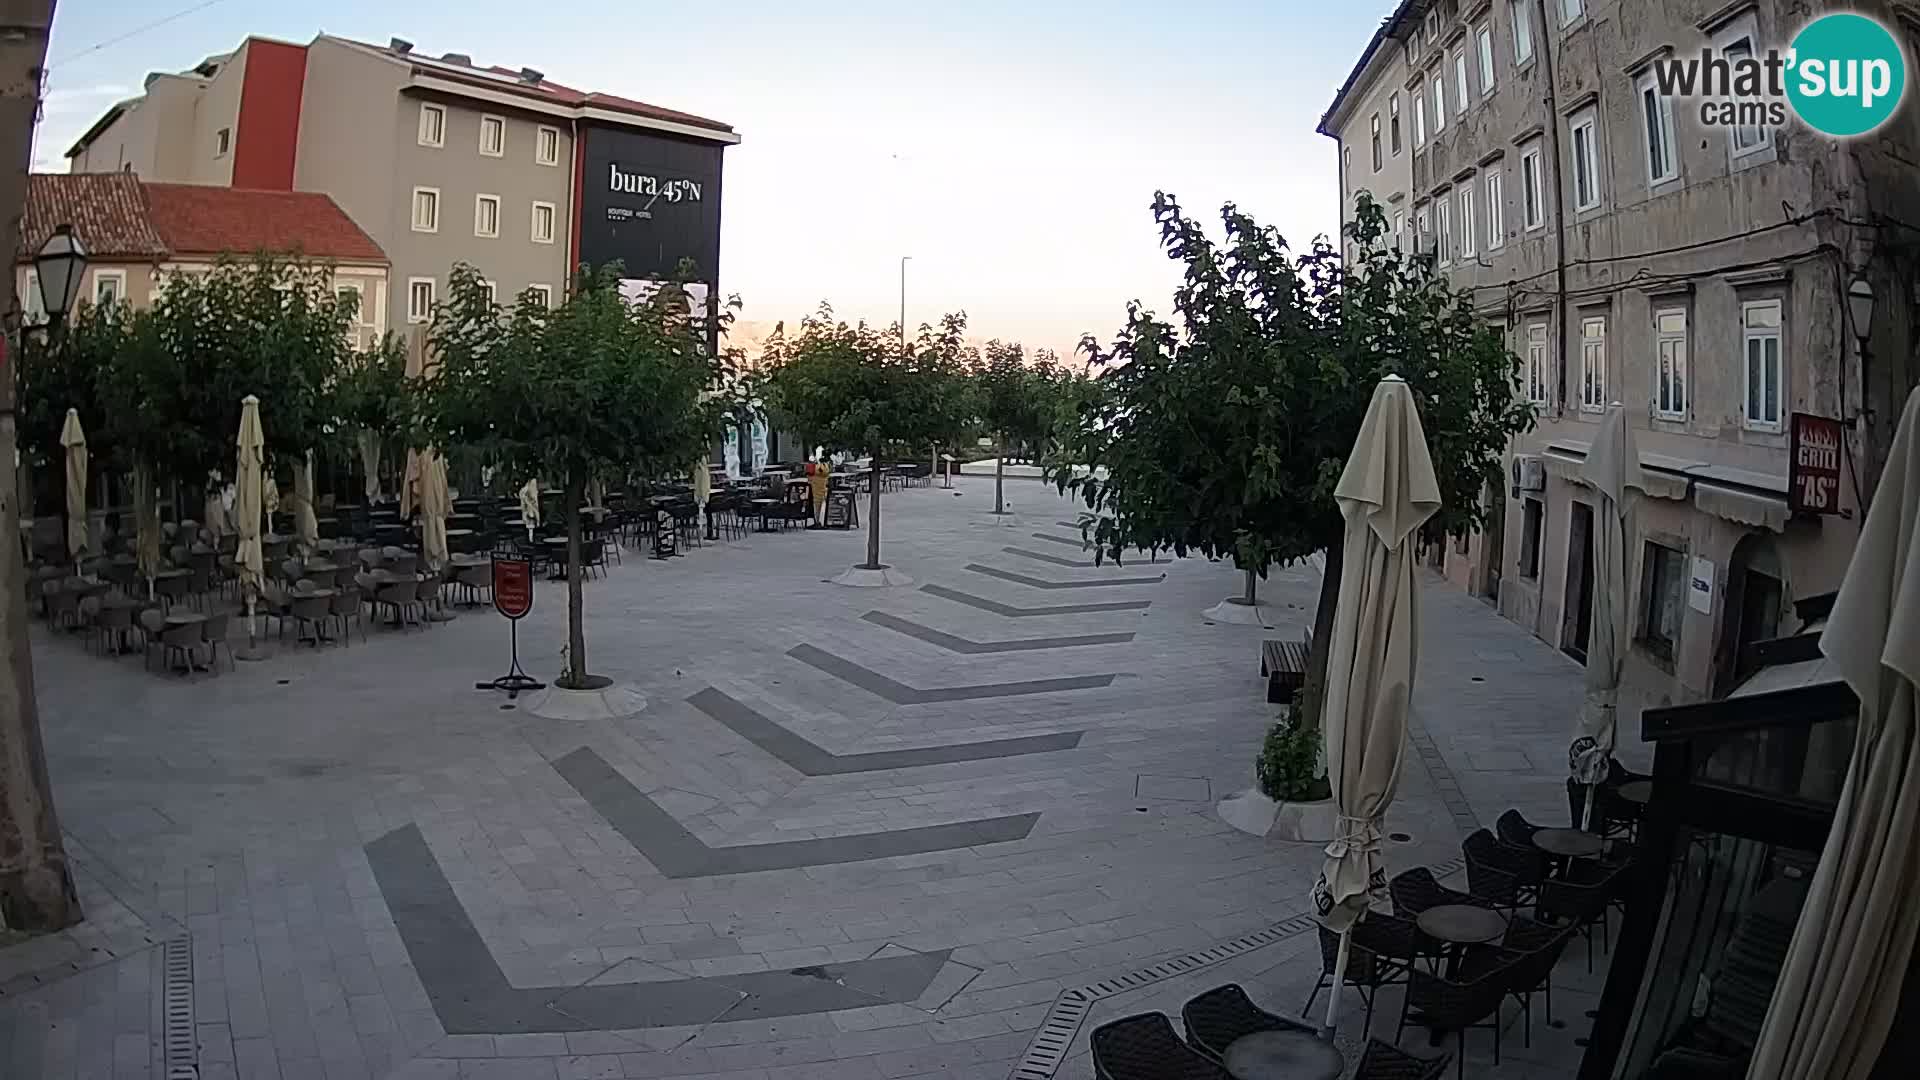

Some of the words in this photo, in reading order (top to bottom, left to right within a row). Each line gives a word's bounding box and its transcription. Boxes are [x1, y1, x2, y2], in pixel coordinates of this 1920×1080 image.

[610, 164, 657, 196] bura
[635, 211, 652, 219] HOTEL
[1798, 446, 1838, 470] GRILL
